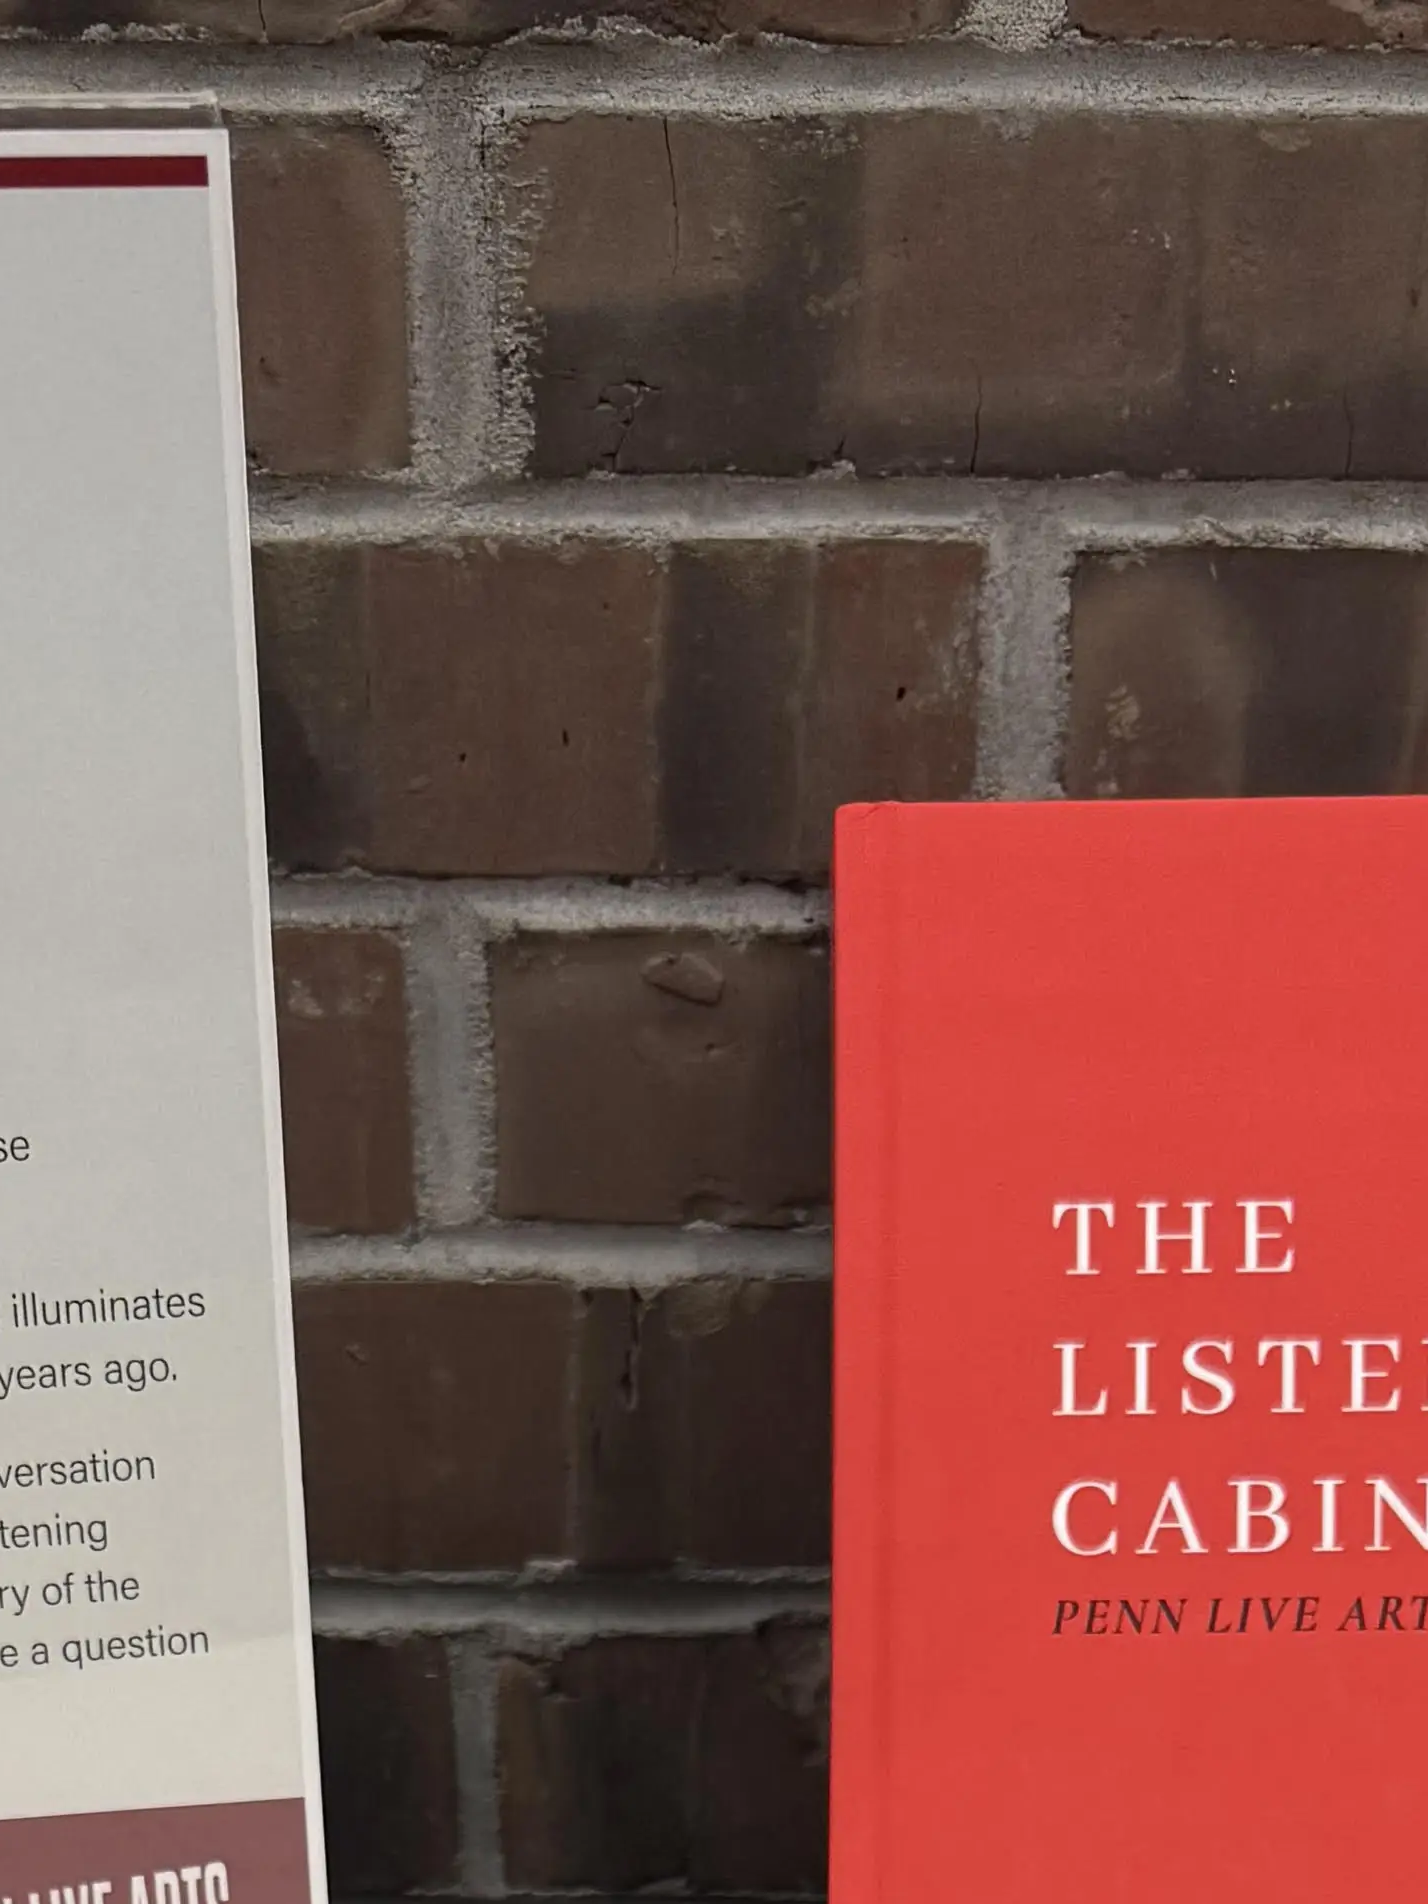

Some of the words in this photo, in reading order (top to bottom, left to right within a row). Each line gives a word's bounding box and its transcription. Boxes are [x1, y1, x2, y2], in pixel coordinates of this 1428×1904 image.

[1051, 1199, 1296, 1276] THE
[11, 1287, 206, 1328] illuminates
[104, 1357, 177, 1393] ago.
[41, 1571, 75, 1606] of
[83, 1569, 140, 1603] the
[1052, 1598, 1187, 1635] PENN
[1205, 1596, 1320, 1634] LIVE
[31, 1642, 50, 1666] a
[61, 1624, 209, 1670] question
